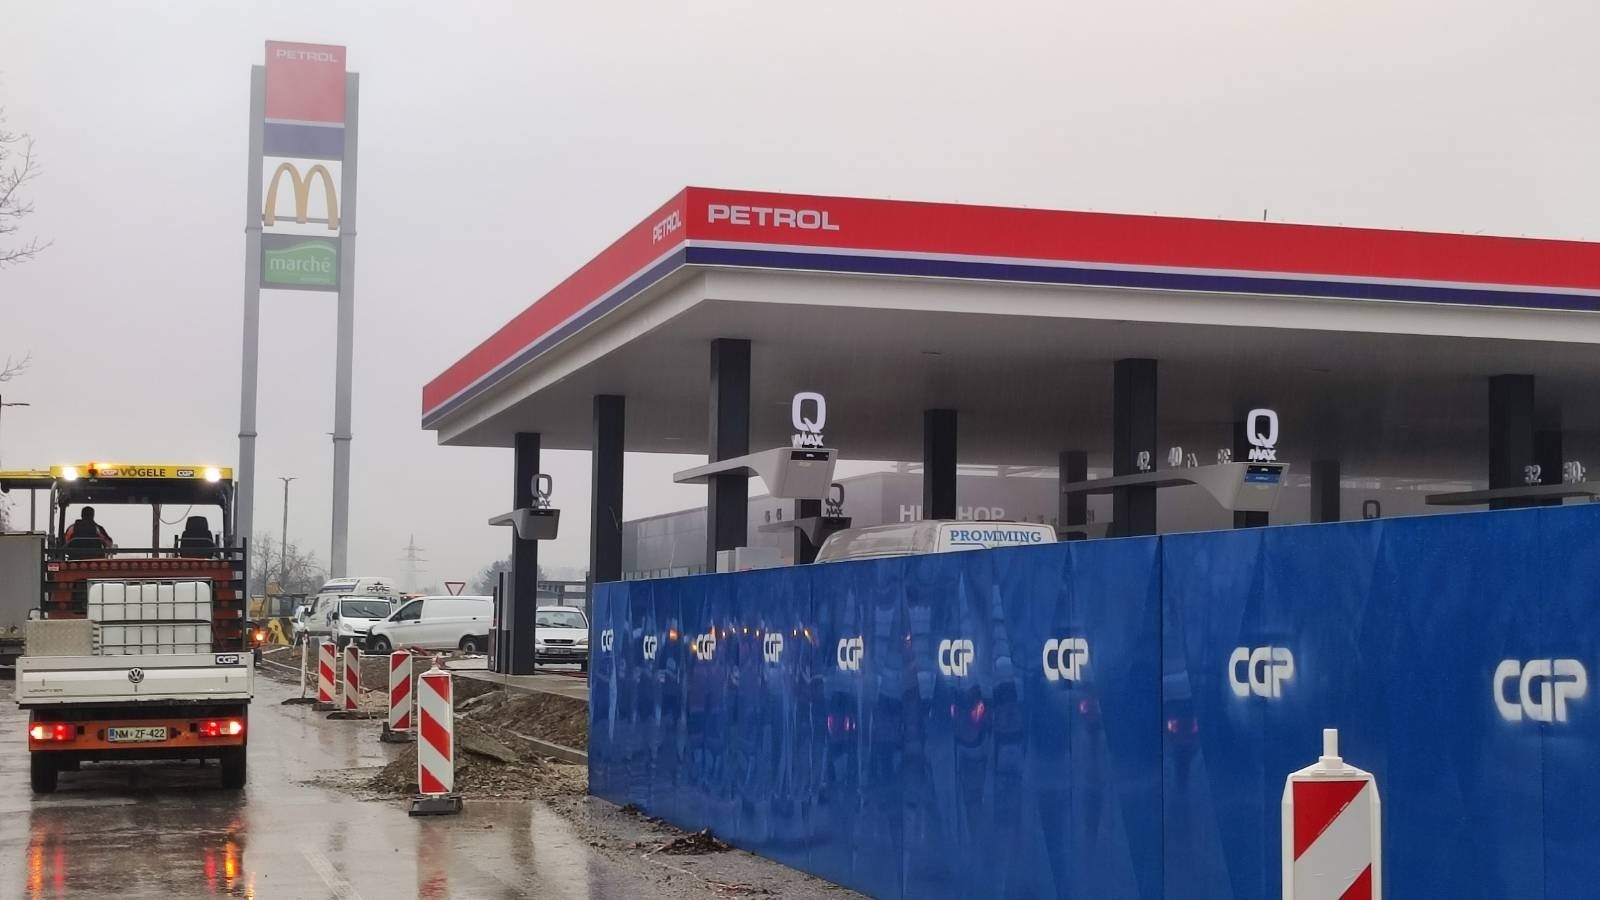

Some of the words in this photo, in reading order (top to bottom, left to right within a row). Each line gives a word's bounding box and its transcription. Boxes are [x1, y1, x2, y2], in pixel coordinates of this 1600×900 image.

[276, 48, 339, 63] PETROL
[652, 209, 682, 245] PETROL
[708, 204, 840, 231] PETROL
[270, 255, 331, 272] marché
[792, 392, 826, 433] Q
[792, 432, 824, 448] MAX
[1247, 409, 1279, 448] Q
[1248, 448, 1277, 461] MAX
[120, 466, 166, 477] VÖGELE
[531, 474, 553, 499] Q
[956, 505, 1005, 521] HOP
[950, 529, 1042, 543] PROMMING
[216, 655, 238, 664] CGP
[643, 635, 657, 660] CGP
[697, 633, 716, 660] CGP
[764, 632, 784, 663] CGP
[837, 638, 864, 671] CGP
[938, 639, 975, 677] CGP
[1042, 638, 1089, 682] CGP
[1228, 646, 1295, 698] CGP
[1493, 659, 1588, 722] CGP
